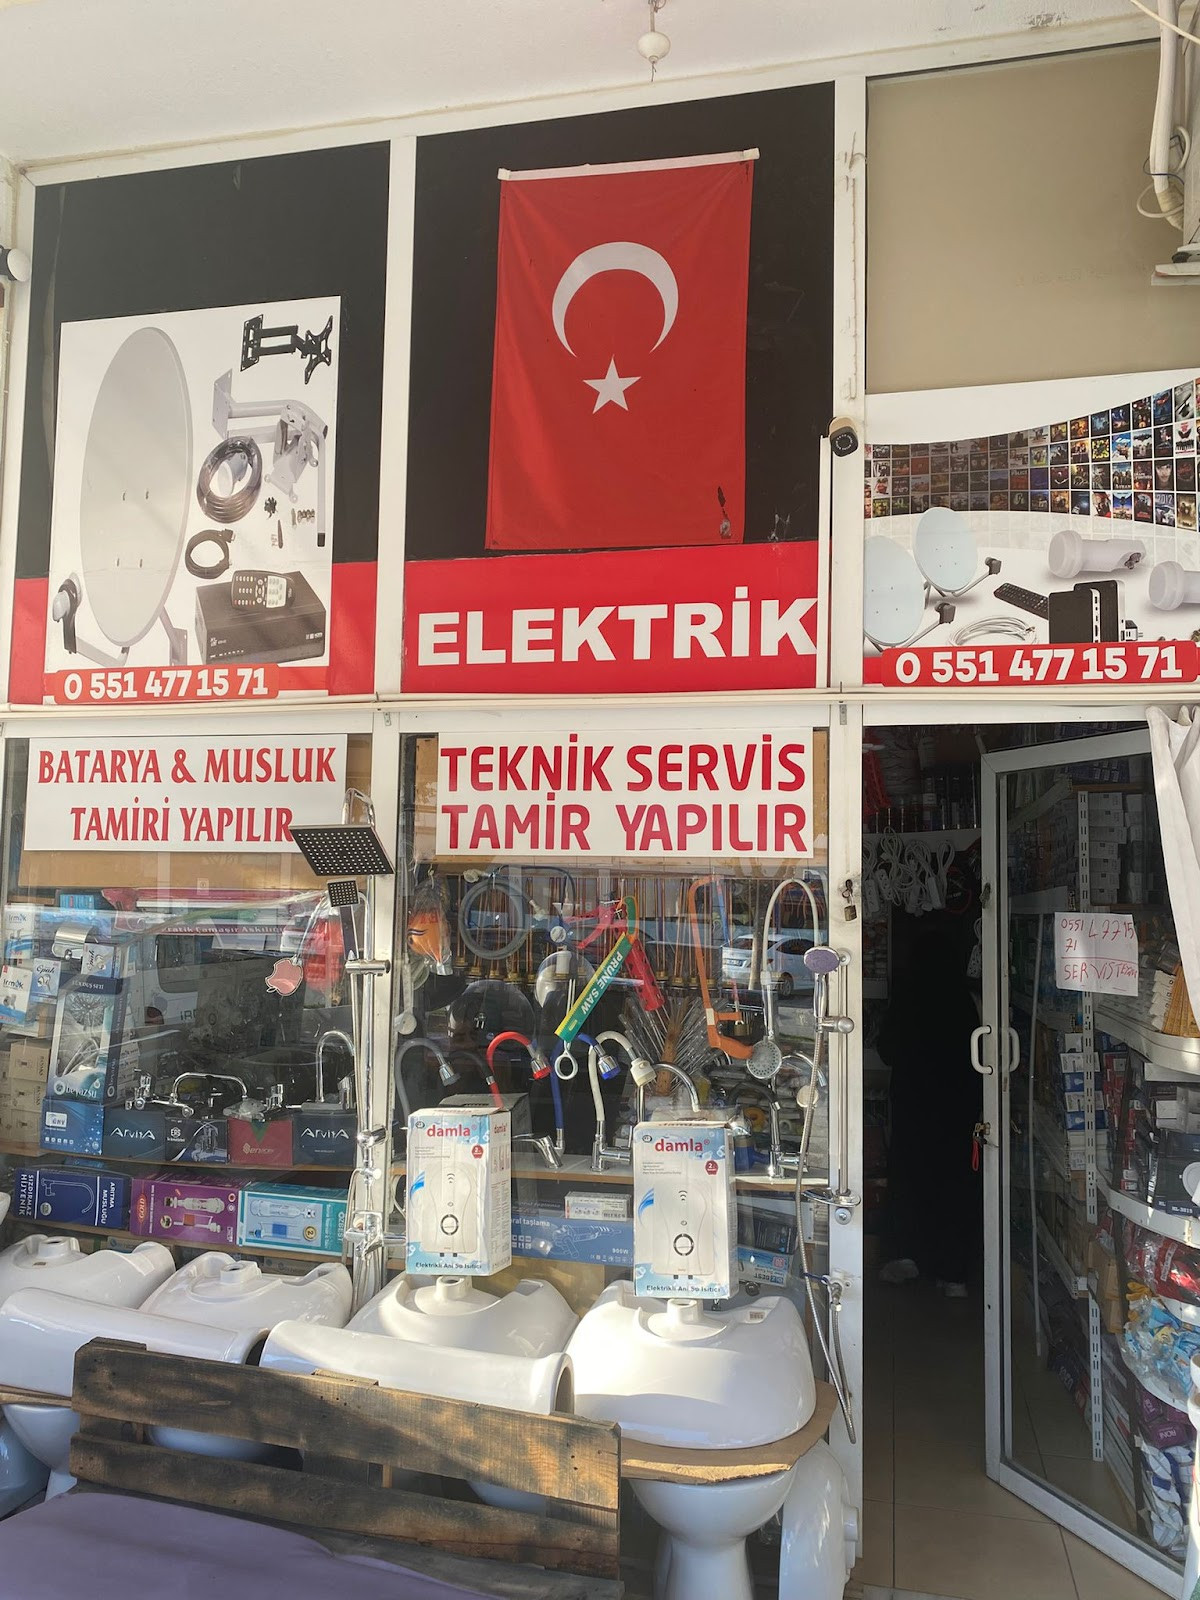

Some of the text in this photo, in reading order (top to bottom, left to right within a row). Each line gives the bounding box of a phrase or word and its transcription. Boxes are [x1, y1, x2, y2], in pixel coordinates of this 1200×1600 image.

[418, 586, 818, 666] ELEKTRİK
[89, 672, 138, 699] 551
[144, 670, 192, 697] 477
[196, 668, 229, 696] 15
[237, 668, 268, 695] 71
[931, 650, 999, 682] 551
[1009, 648, 1074, 680] 477
[1082, 647, 1127, 680] 15
[1137, 645, 1182, 679] 71
[38, 747, 336, 784] BATARYA & MUSLUK
[441, 733, 806, 792] TEKNİK SERVİS
[70, 796, 294, 842] TAMİRİ YAPILIR
[441, 792, 807, 852] TAMİR YAPILIR
[580, 951, 623, 1014] PRUNE SAW
[427, 1124, 470, 1137] damla
[655, 1138, 703, 1152] damla
